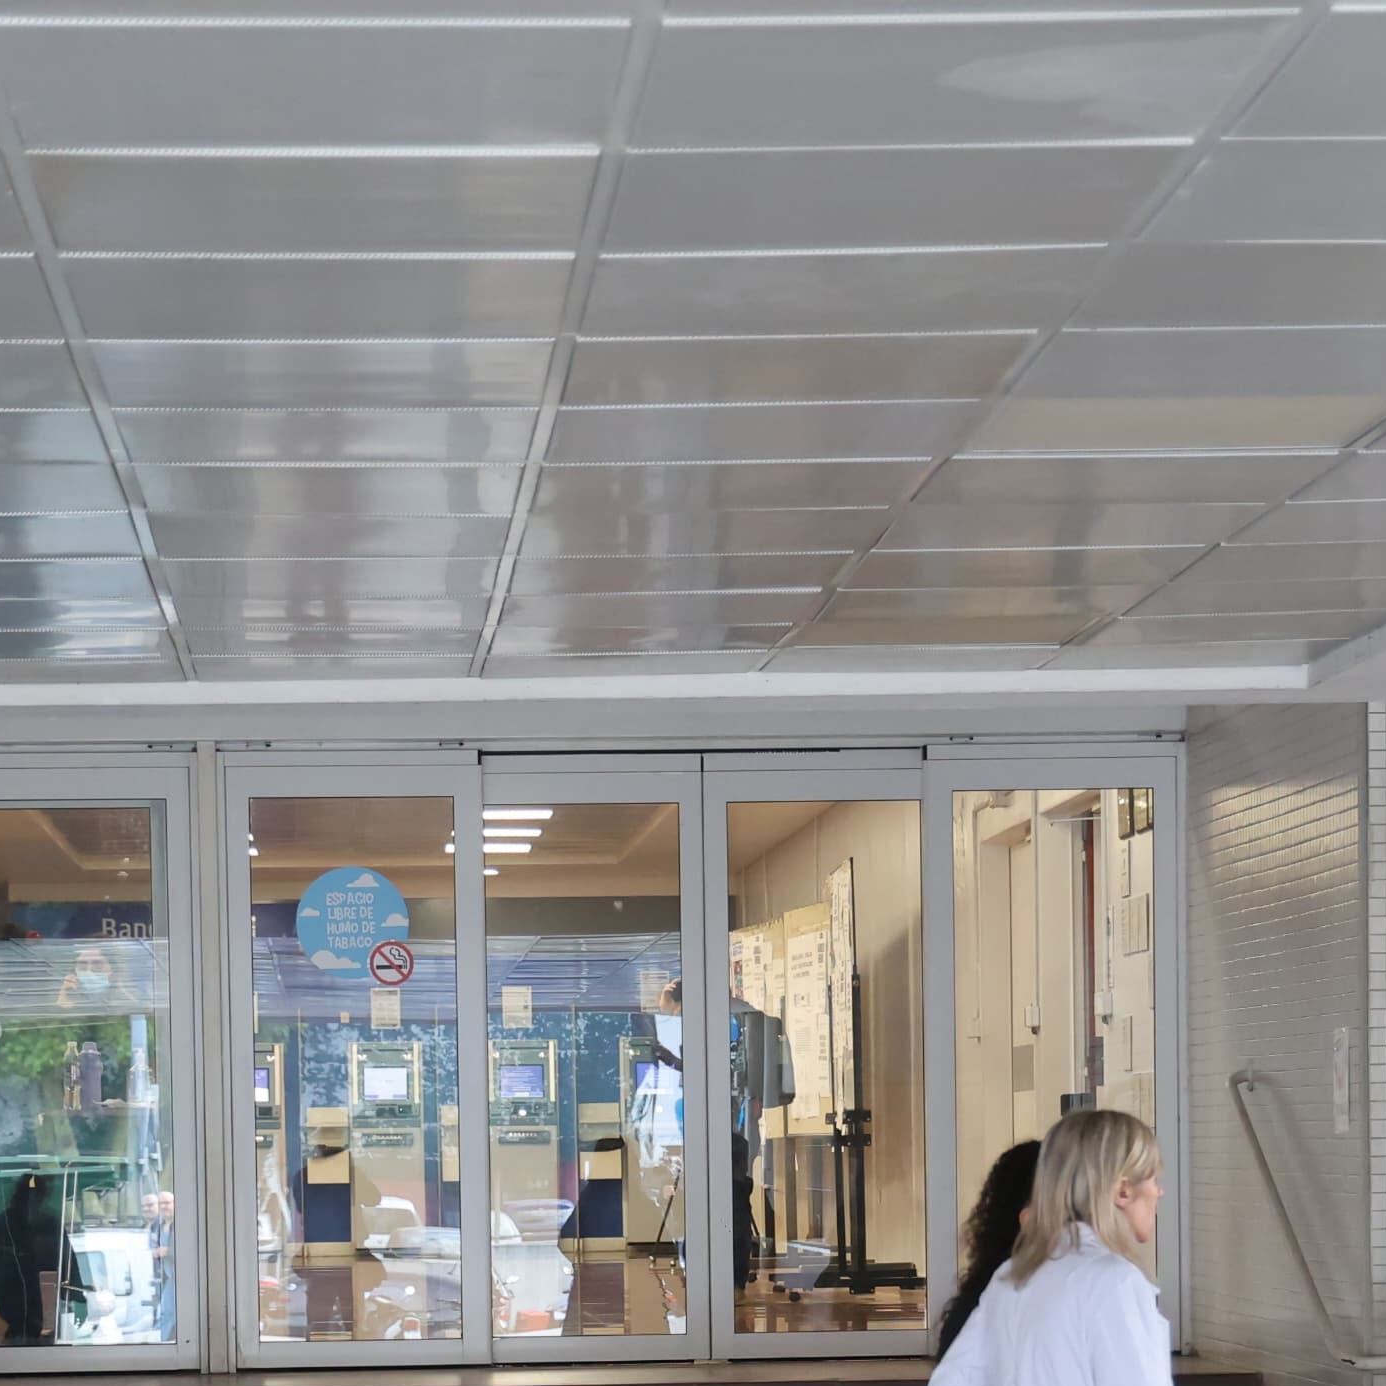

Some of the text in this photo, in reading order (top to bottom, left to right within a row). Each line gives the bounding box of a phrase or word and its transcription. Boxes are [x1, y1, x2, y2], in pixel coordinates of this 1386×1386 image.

[325, 892, 374, 906] ESPACIO
[327, 907, 374, 920] LIBRE DE
[327, 921, 376, 935] HUMO DE
[327, 936, 373, 949] TABACO
